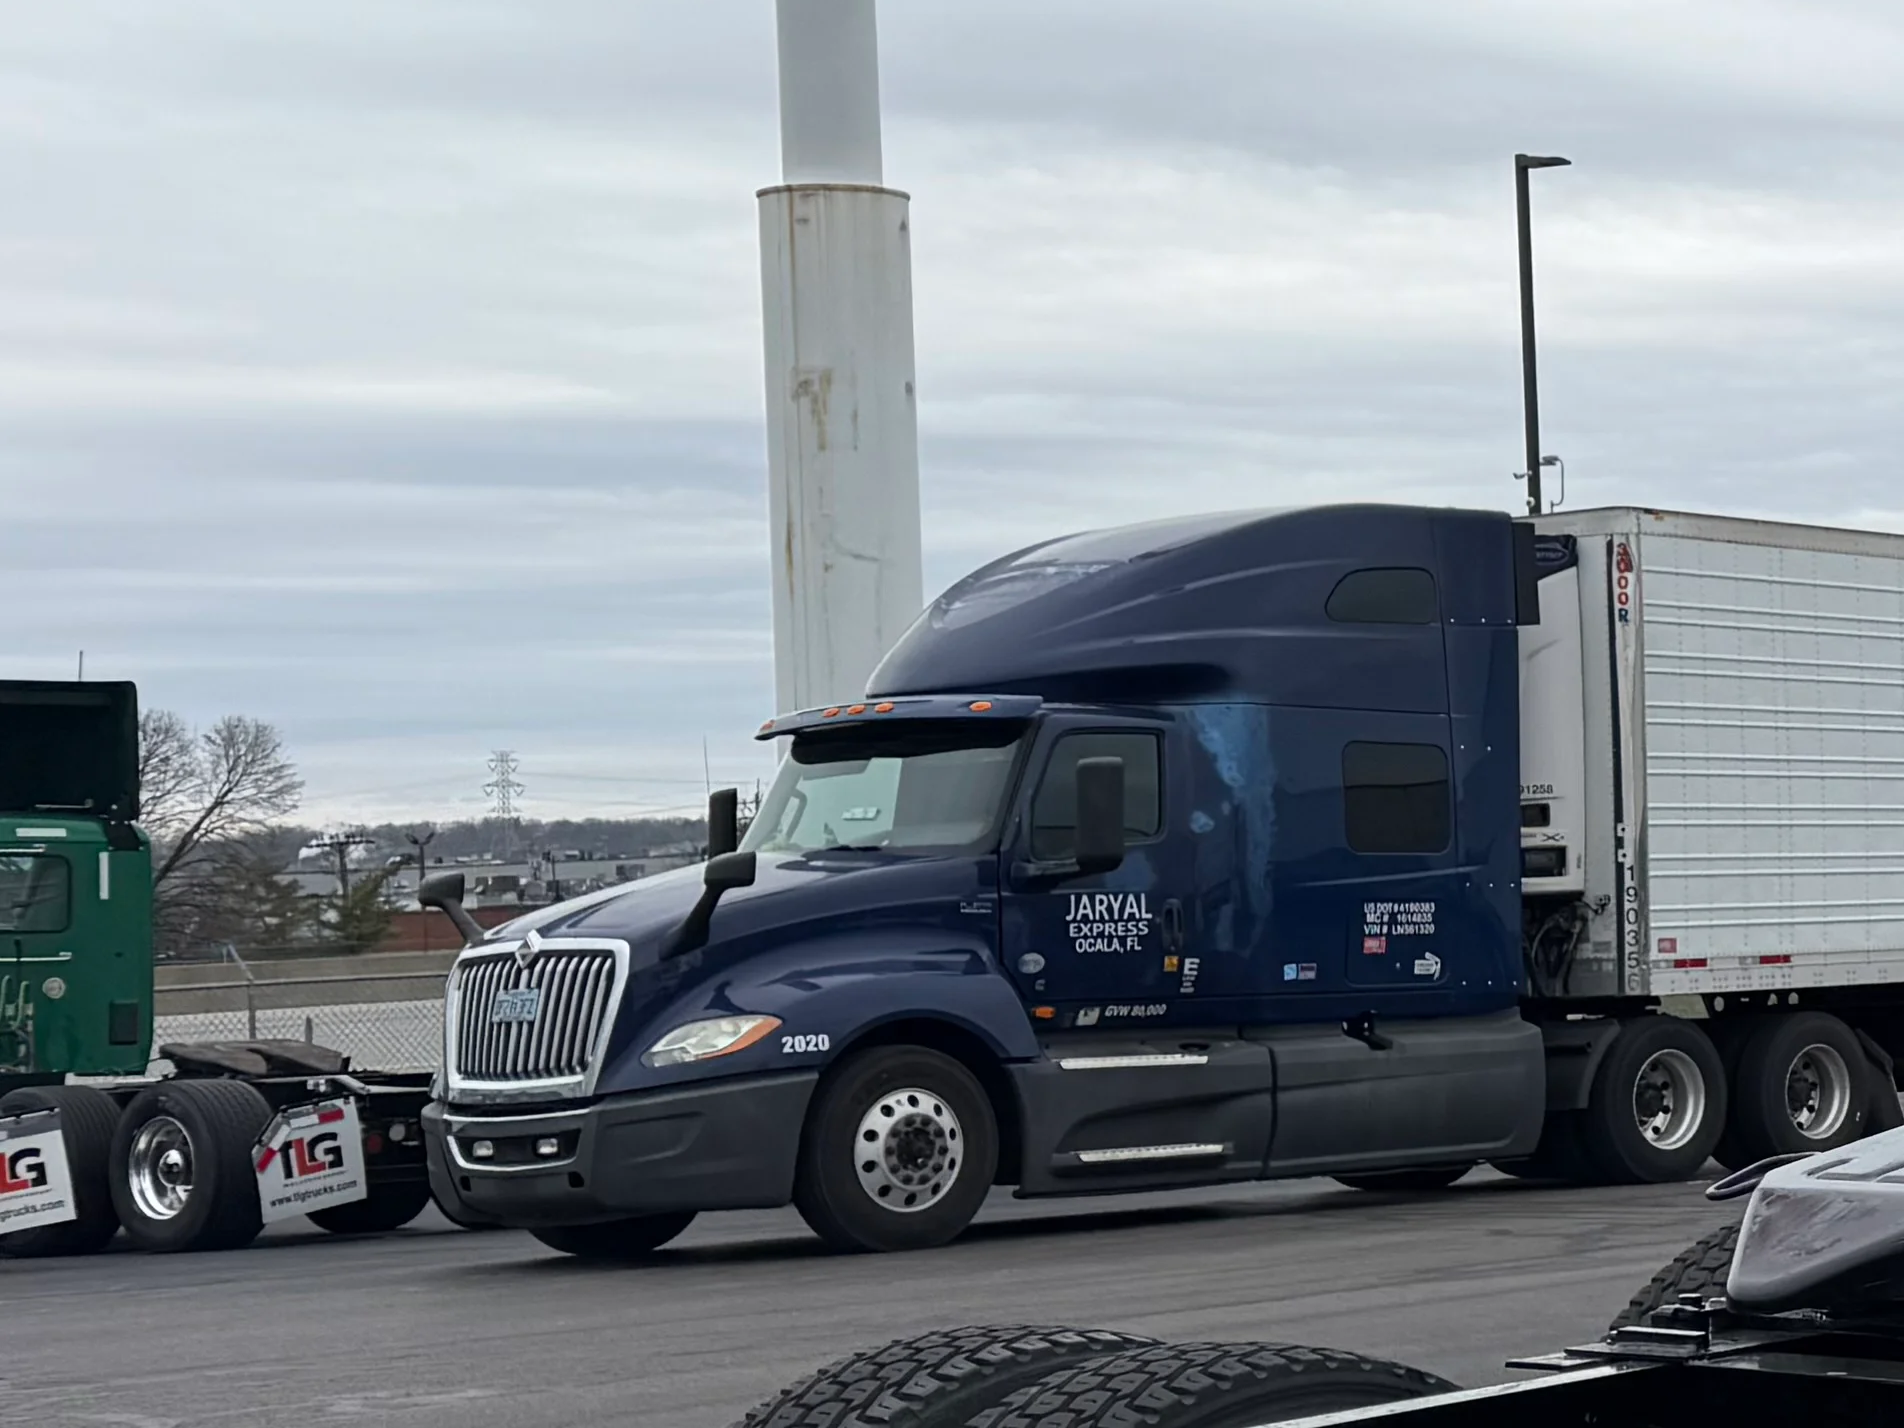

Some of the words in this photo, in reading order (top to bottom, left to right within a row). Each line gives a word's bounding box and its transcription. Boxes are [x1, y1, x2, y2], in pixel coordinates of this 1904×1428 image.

[1065, 892, 1153, 921] JARYAL
[1069, 921, 1149, 937] EXPRESS
[1075, 937, 1124, 953] OCALA,
[1127, 936, 1142, 951] FL
[1105, 1005, 1131, 1017] GVW
[781, 1034, 830, 1053] 2020
